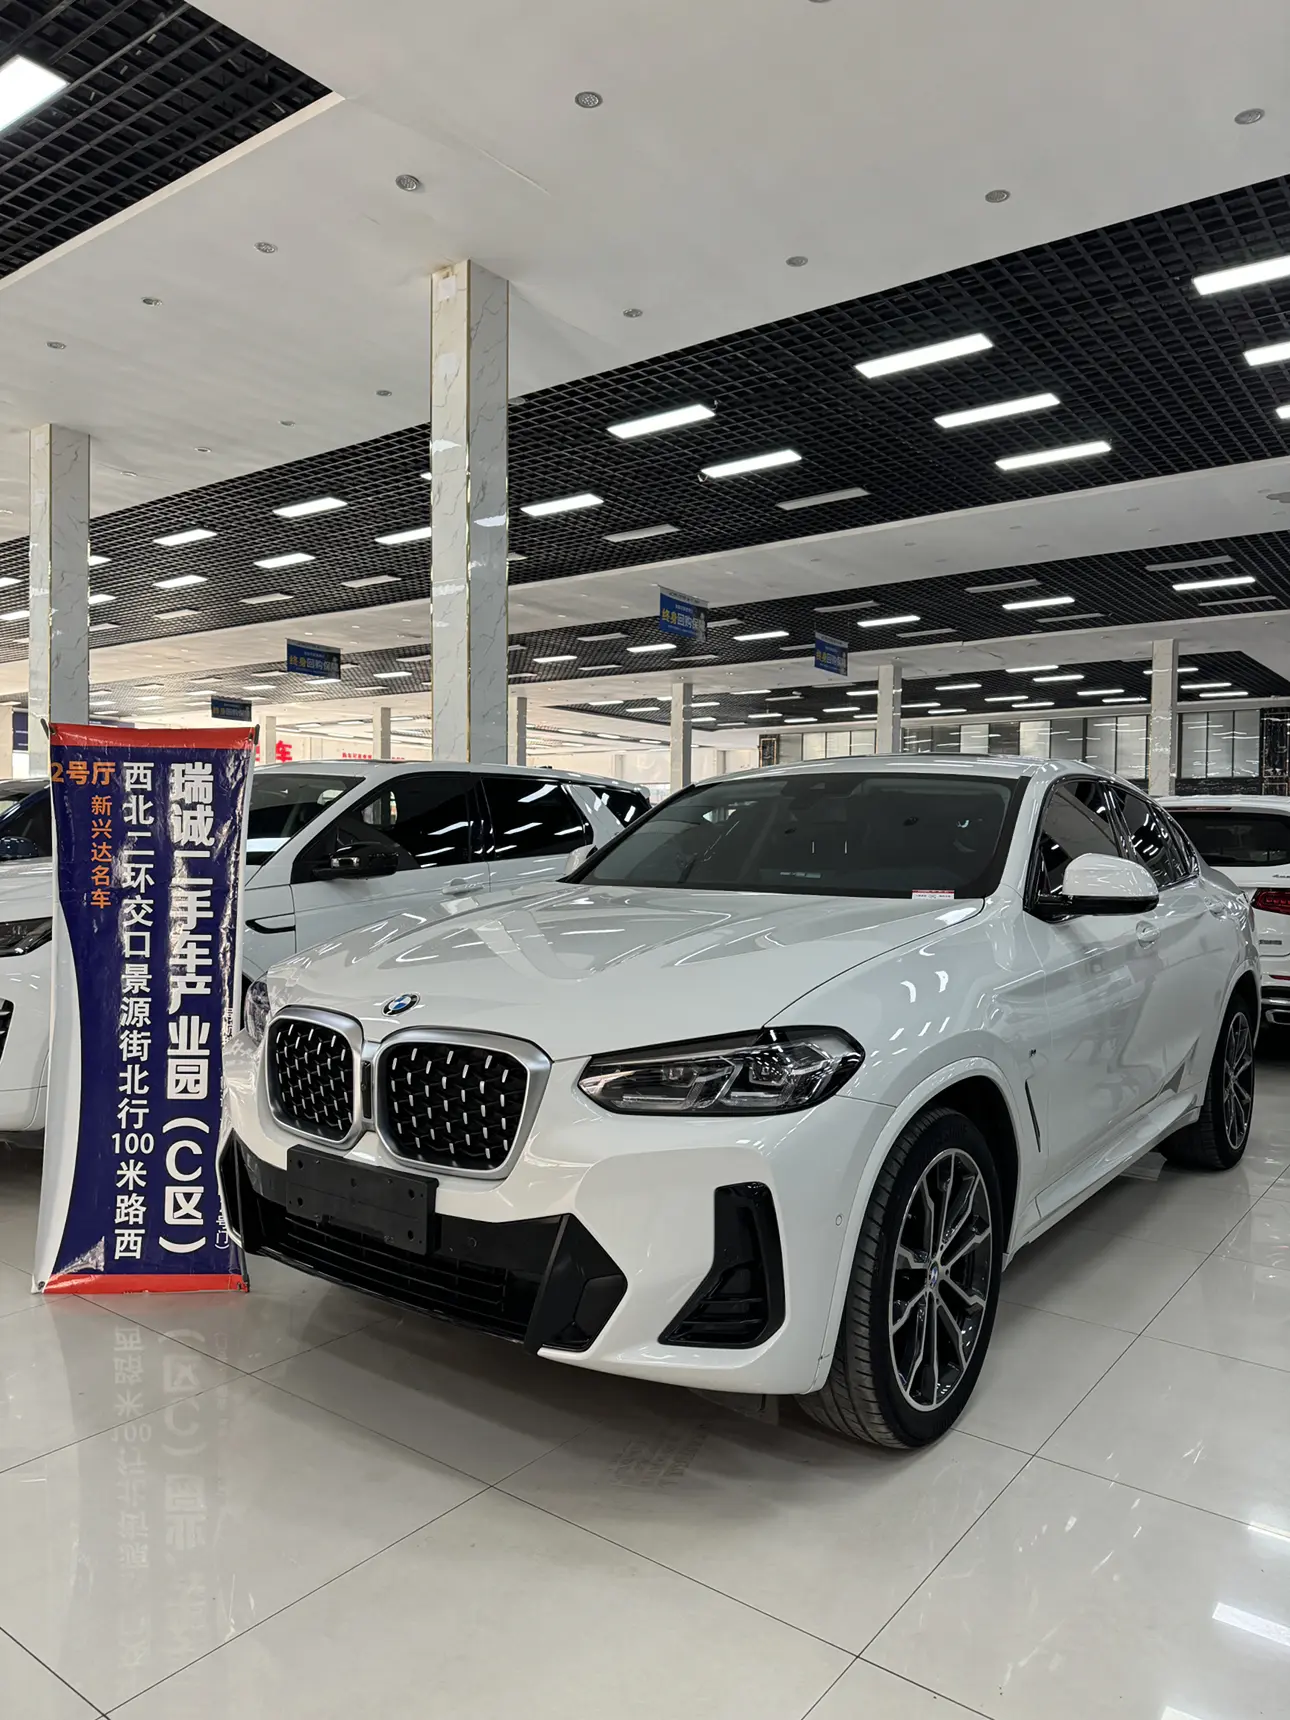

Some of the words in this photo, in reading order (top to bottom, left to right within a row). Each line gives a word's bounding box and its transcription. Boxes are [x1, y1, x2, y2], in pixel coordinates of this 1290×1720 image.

[51, 761, 116, 786] 2号厅
[91, 795, 112, 909] 新兴达名车
[111, 762, 155, 1260] 西北二环交口景源街北行100米路西
